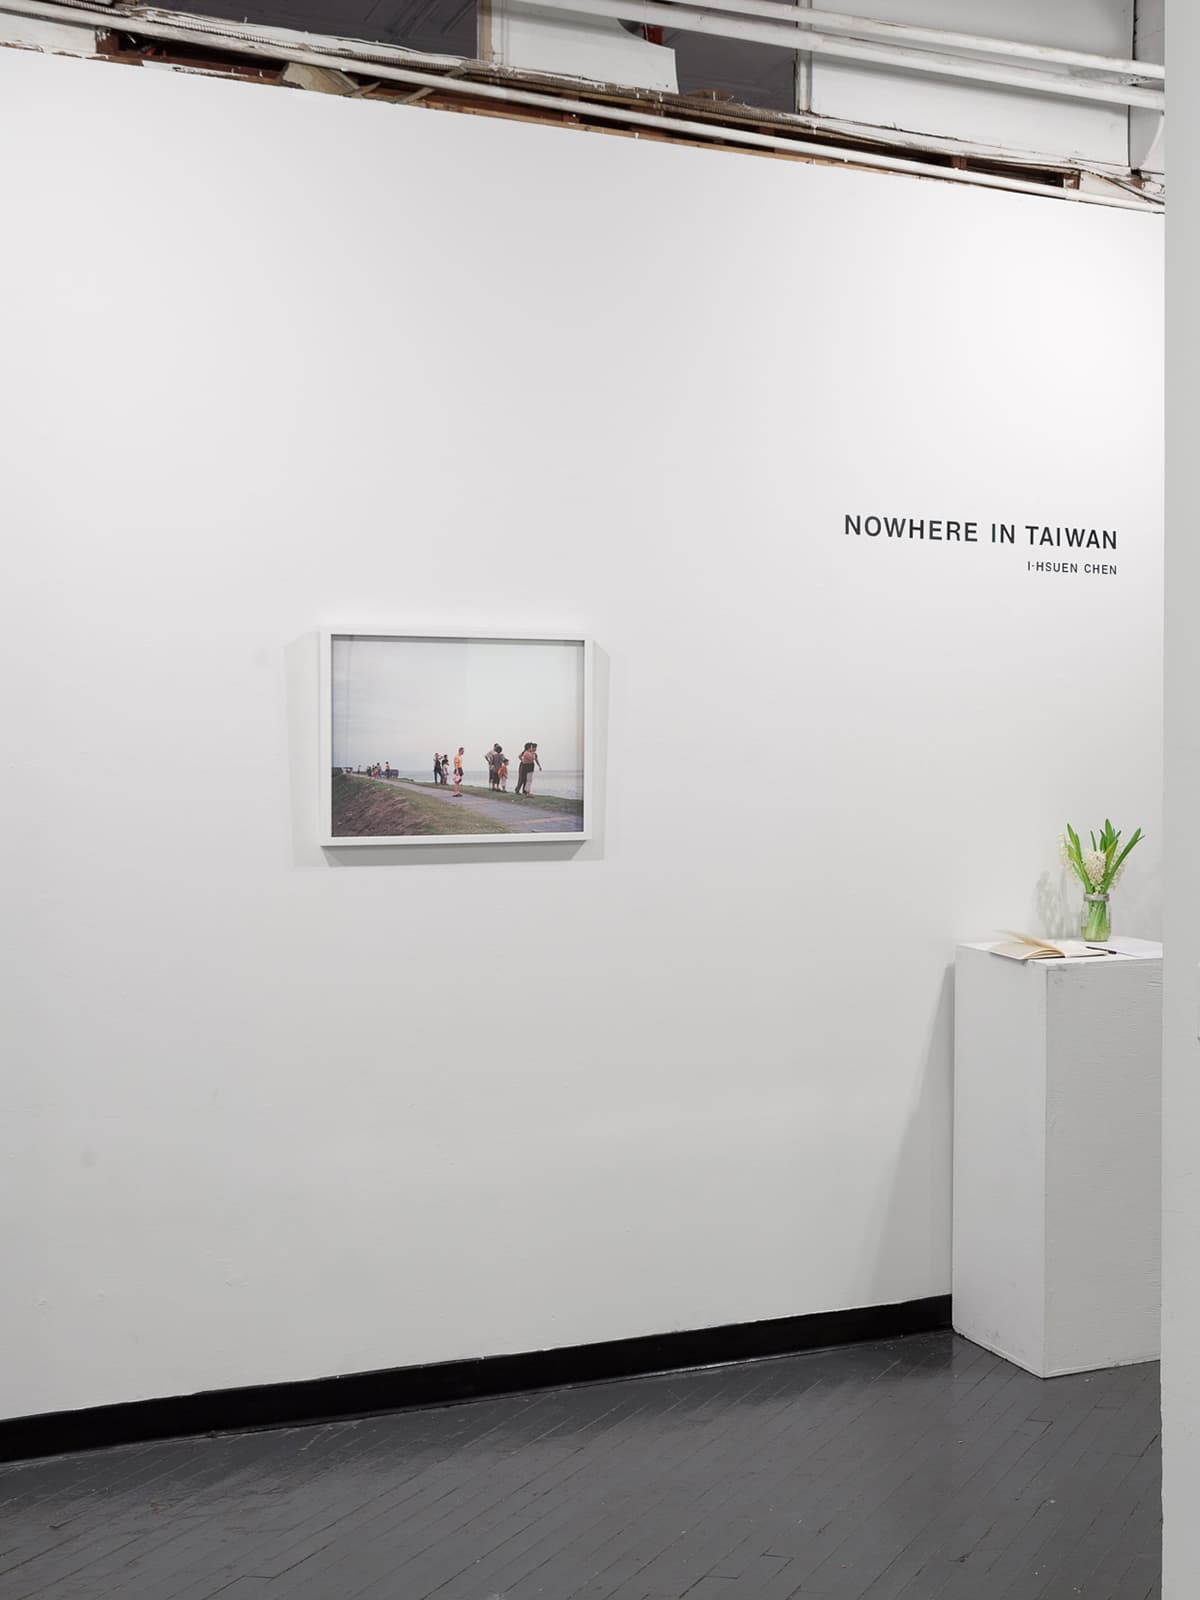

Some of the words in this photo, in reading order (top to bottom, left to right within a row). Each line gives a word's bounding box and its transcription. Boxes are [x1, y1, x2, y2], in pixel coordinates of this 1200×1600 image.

[844, 514, 977, 543] NOWHERE
[991, 523, 1015, 545] IN
[1025, 525, 1117, 550] TAIWAN
[1027, 560, 1078, 574] I-HSUEN
[1083, 563, 1117, 576] CHEN
